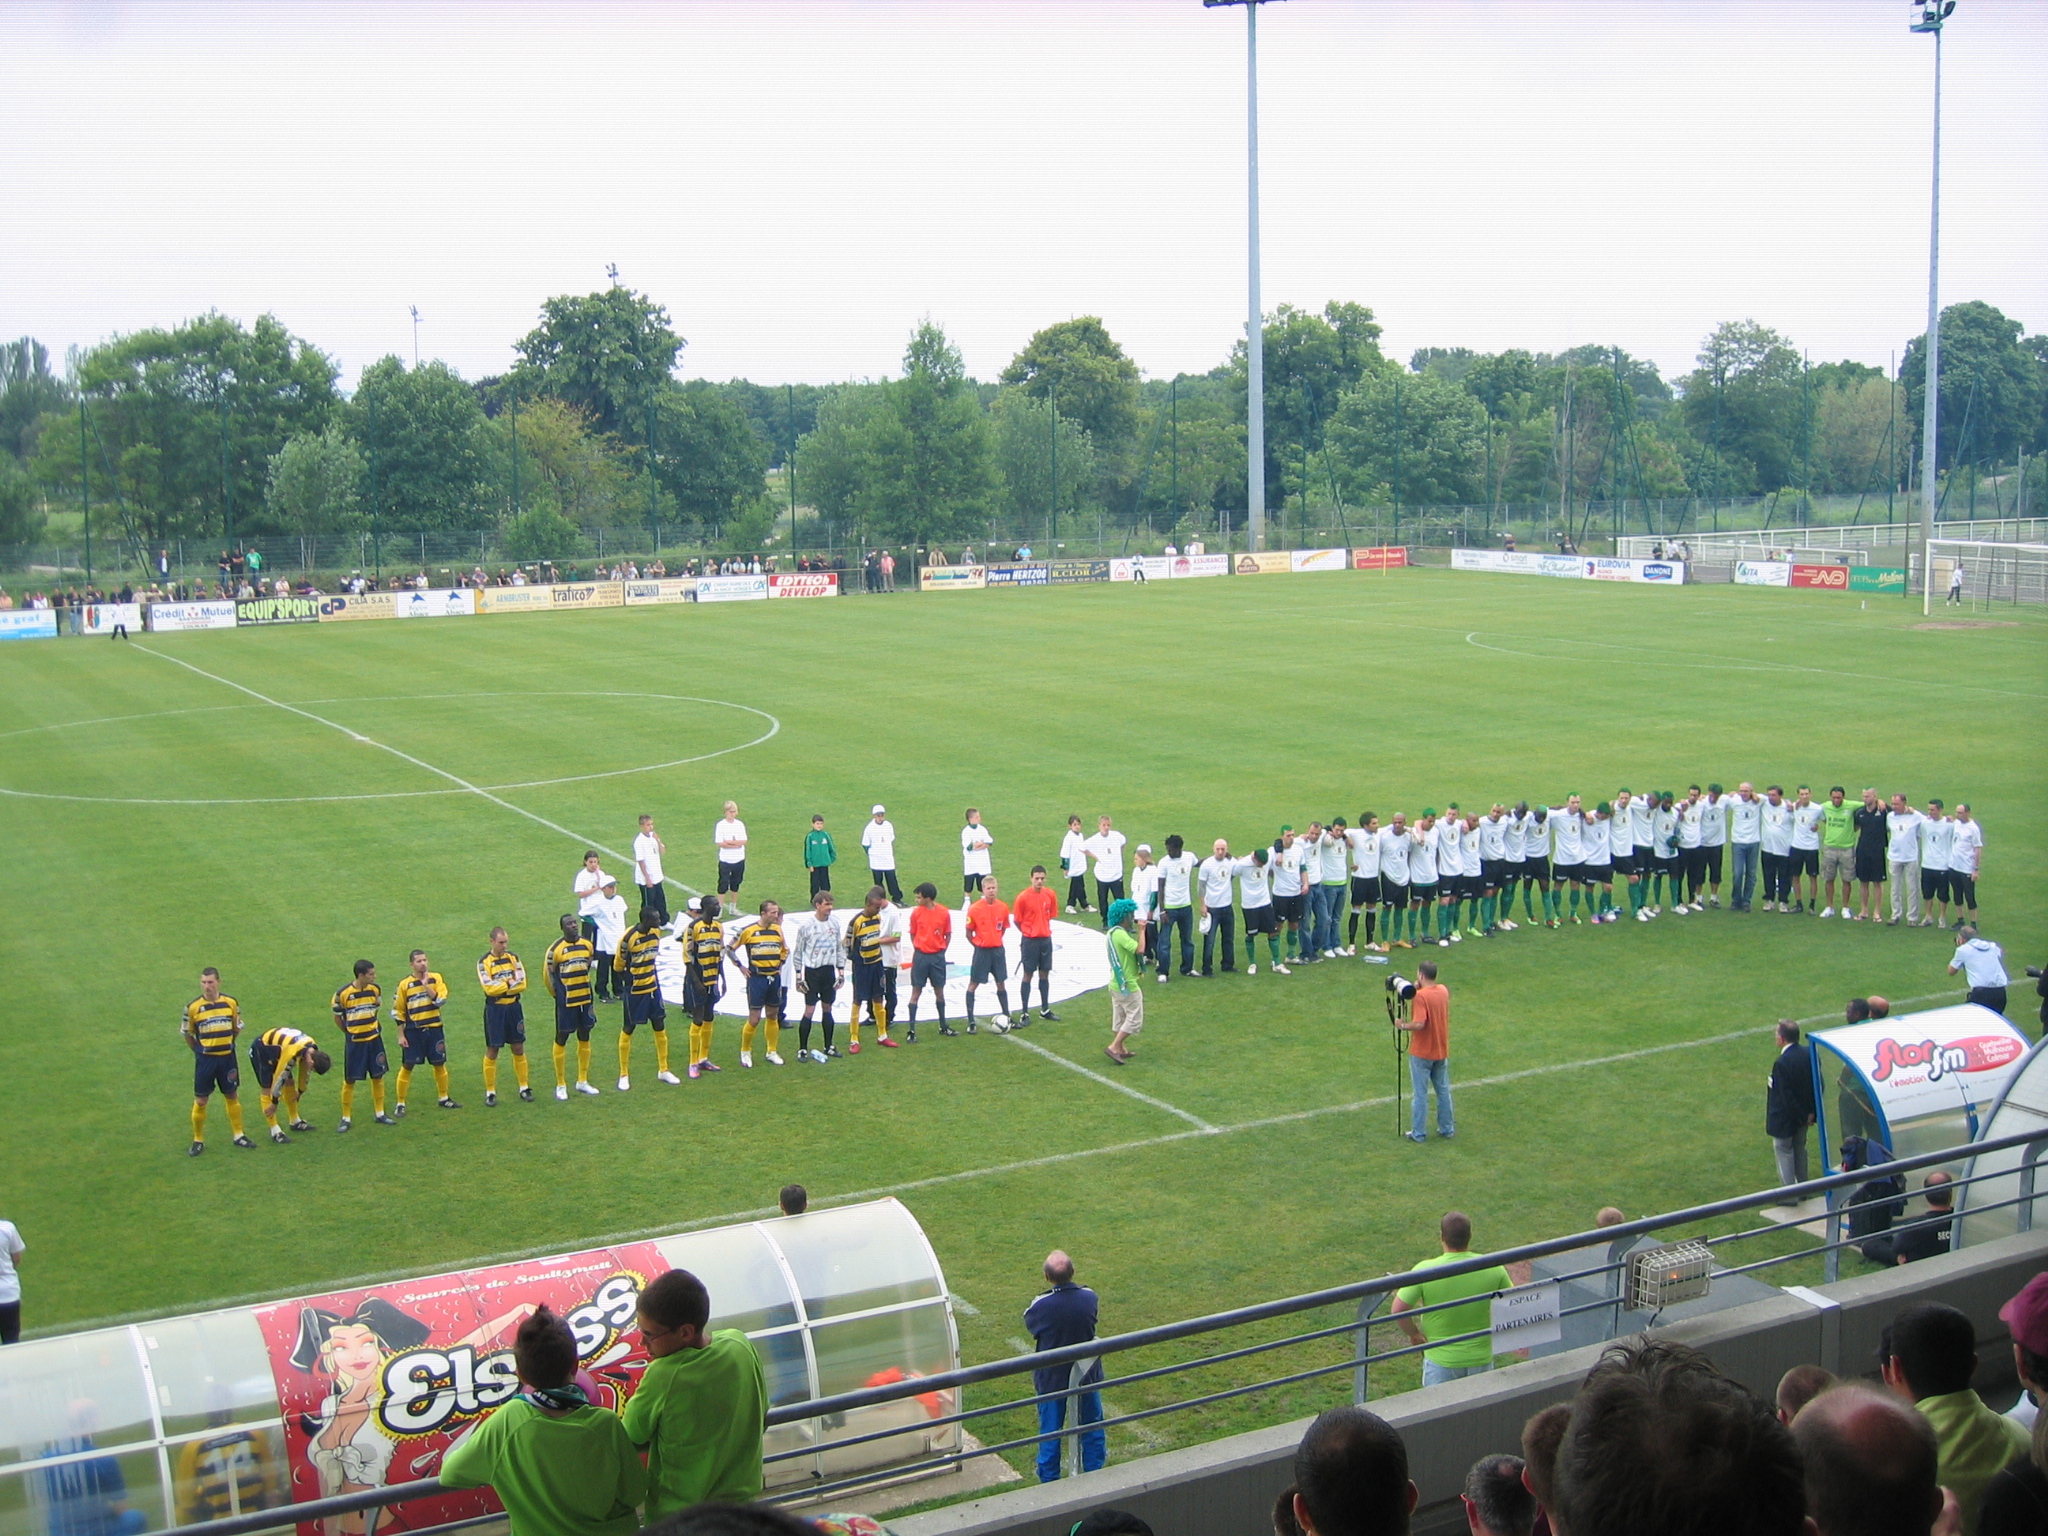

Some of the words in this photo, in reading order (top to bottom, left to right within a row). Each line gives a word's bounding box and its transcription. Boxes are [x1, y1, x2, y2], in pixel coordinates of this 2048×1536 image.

[1193, 556, 1227, 564] ASSURANCES
[1597, 559, 1631, 569] EUROVIA
[988, 571, 1011, 581] Pierre
[1012, 569, 1047, 580] HERTZOG
[1644, 566, 1671, 576] DANONE
[776, 574, 830, 586] EDYTECh
[552, 586, 586, 603] trafico
[780, 587, 827, 597] DEVELOP
[153, 608, 185, 619] Crédit
[200, 606, 235, 617] Mutuel
[238, 597, 318, 620] EQUIP'SPORT
[1983, 1044, 2015, 1056] Mulhouse
[1986, 1052, 2010, 1063] Colmar
[1888, 1075, 1927, 1088] l'émotion
[1937, 1230, 1951, 1241] SEC
[401, 1283, 481, 1304] Sources
[485, 1278, 510, 1289] de
[1508, 1292, 1542, 1307] ESPACE
[1495, 1311, 1554, 1333] PARTENAIRES
[383, 1275, 640, 1433] Elsss
